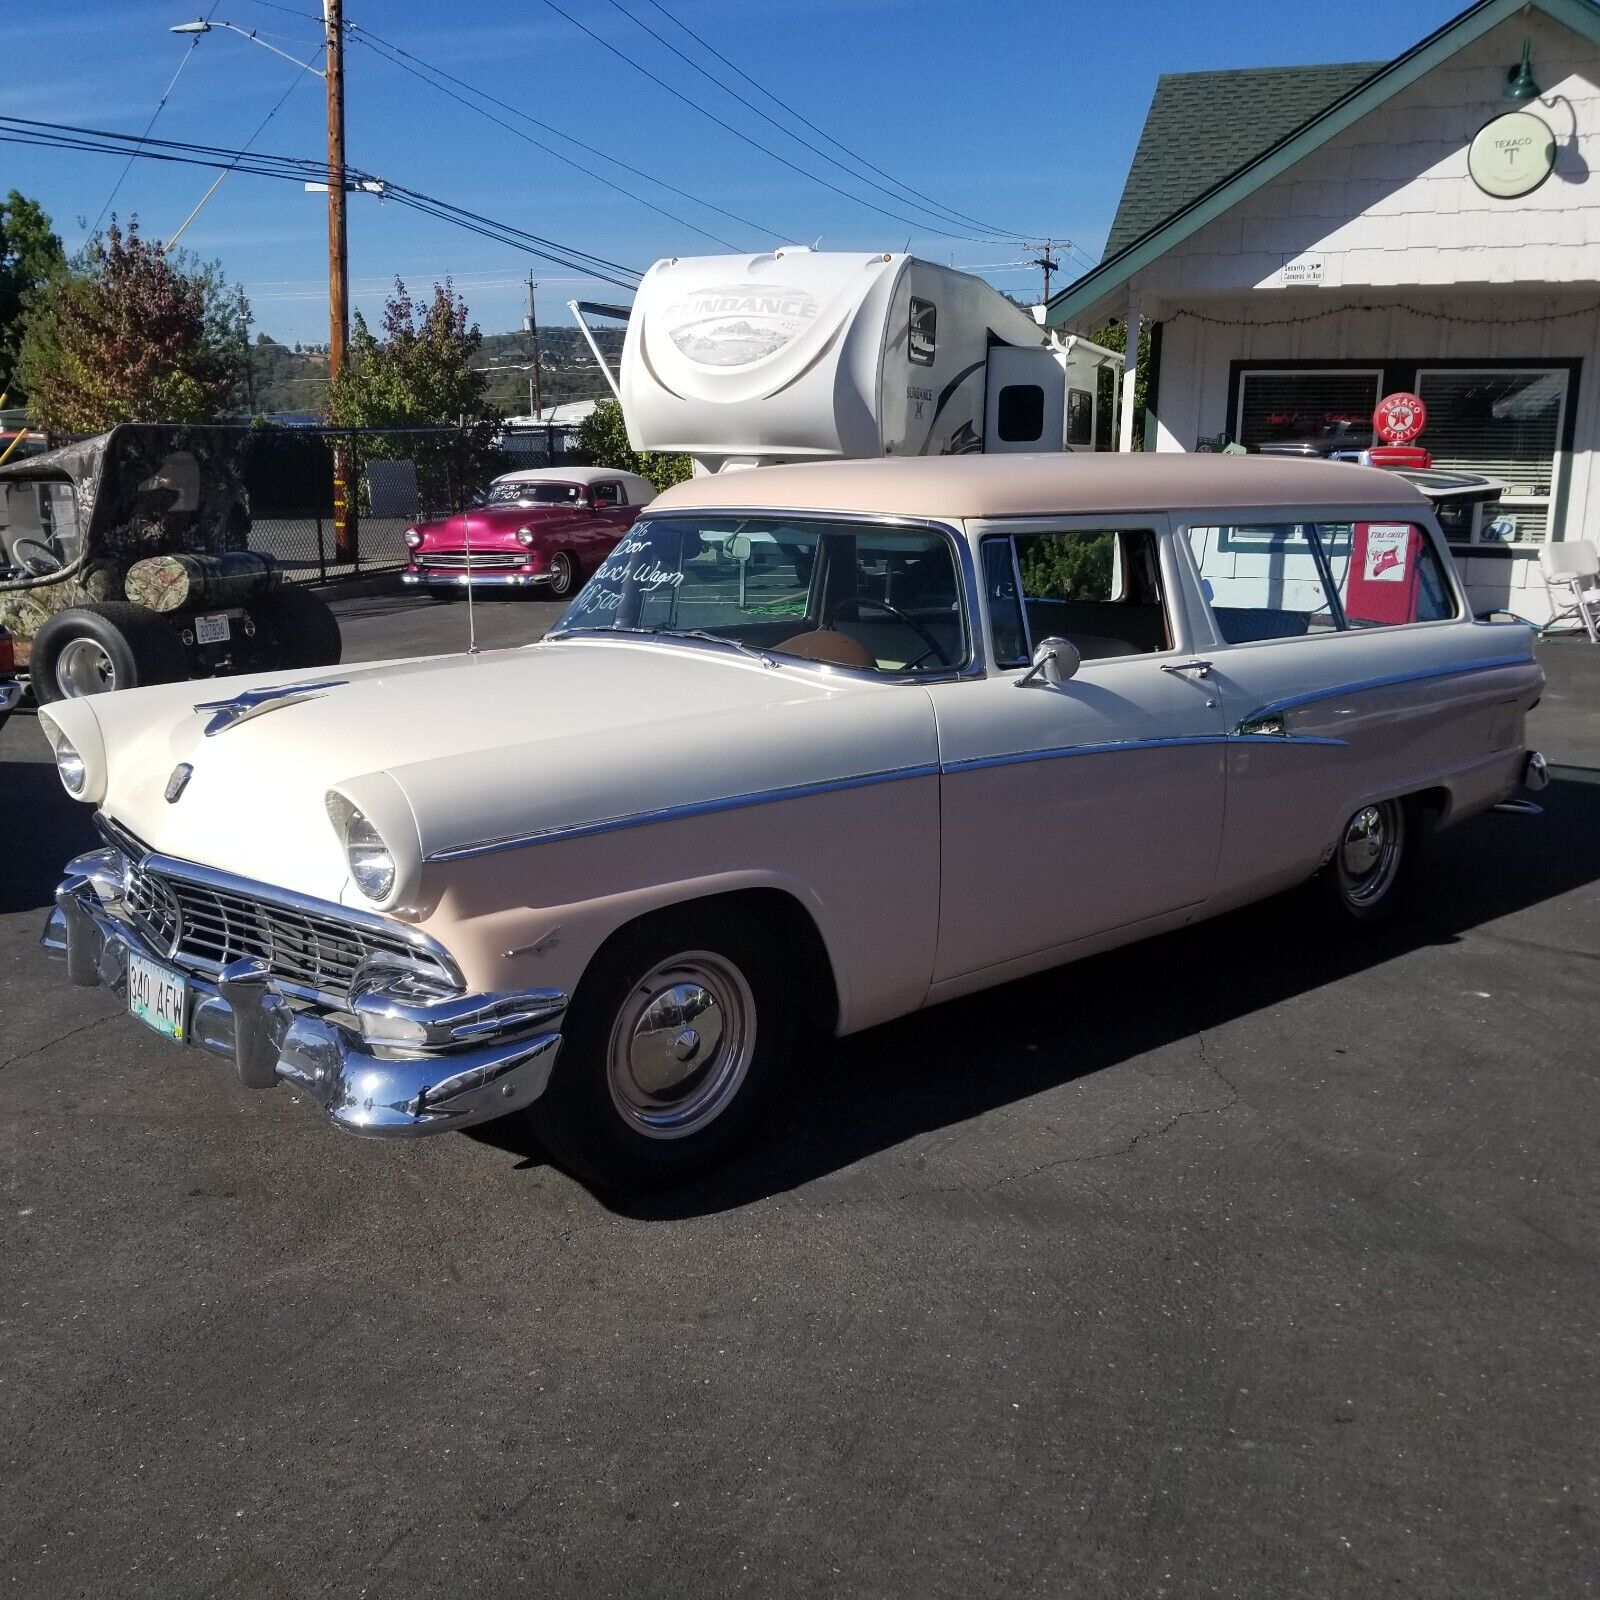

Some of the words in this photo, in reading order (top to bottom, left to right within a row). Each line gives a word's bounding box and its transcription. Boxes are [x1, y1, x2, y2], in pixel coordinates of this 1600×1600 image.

[1494, 137, 1532, 149] TEXACO
[1283, 272, 1304, 280] Cameras
[1284, 264, 1305, 273] Security
[661, 298, 818, 320] SUNDANCE
[1380, 398, 1421, 414] TEXACO
[1382, 426, 1418, 439] ETHYL
[609, 539, 652, 557] Door
[633, 560, 684, 592] Wagon
[131, 965, 150, 1009] 340
[156, 980, 183, 1026] AFW
